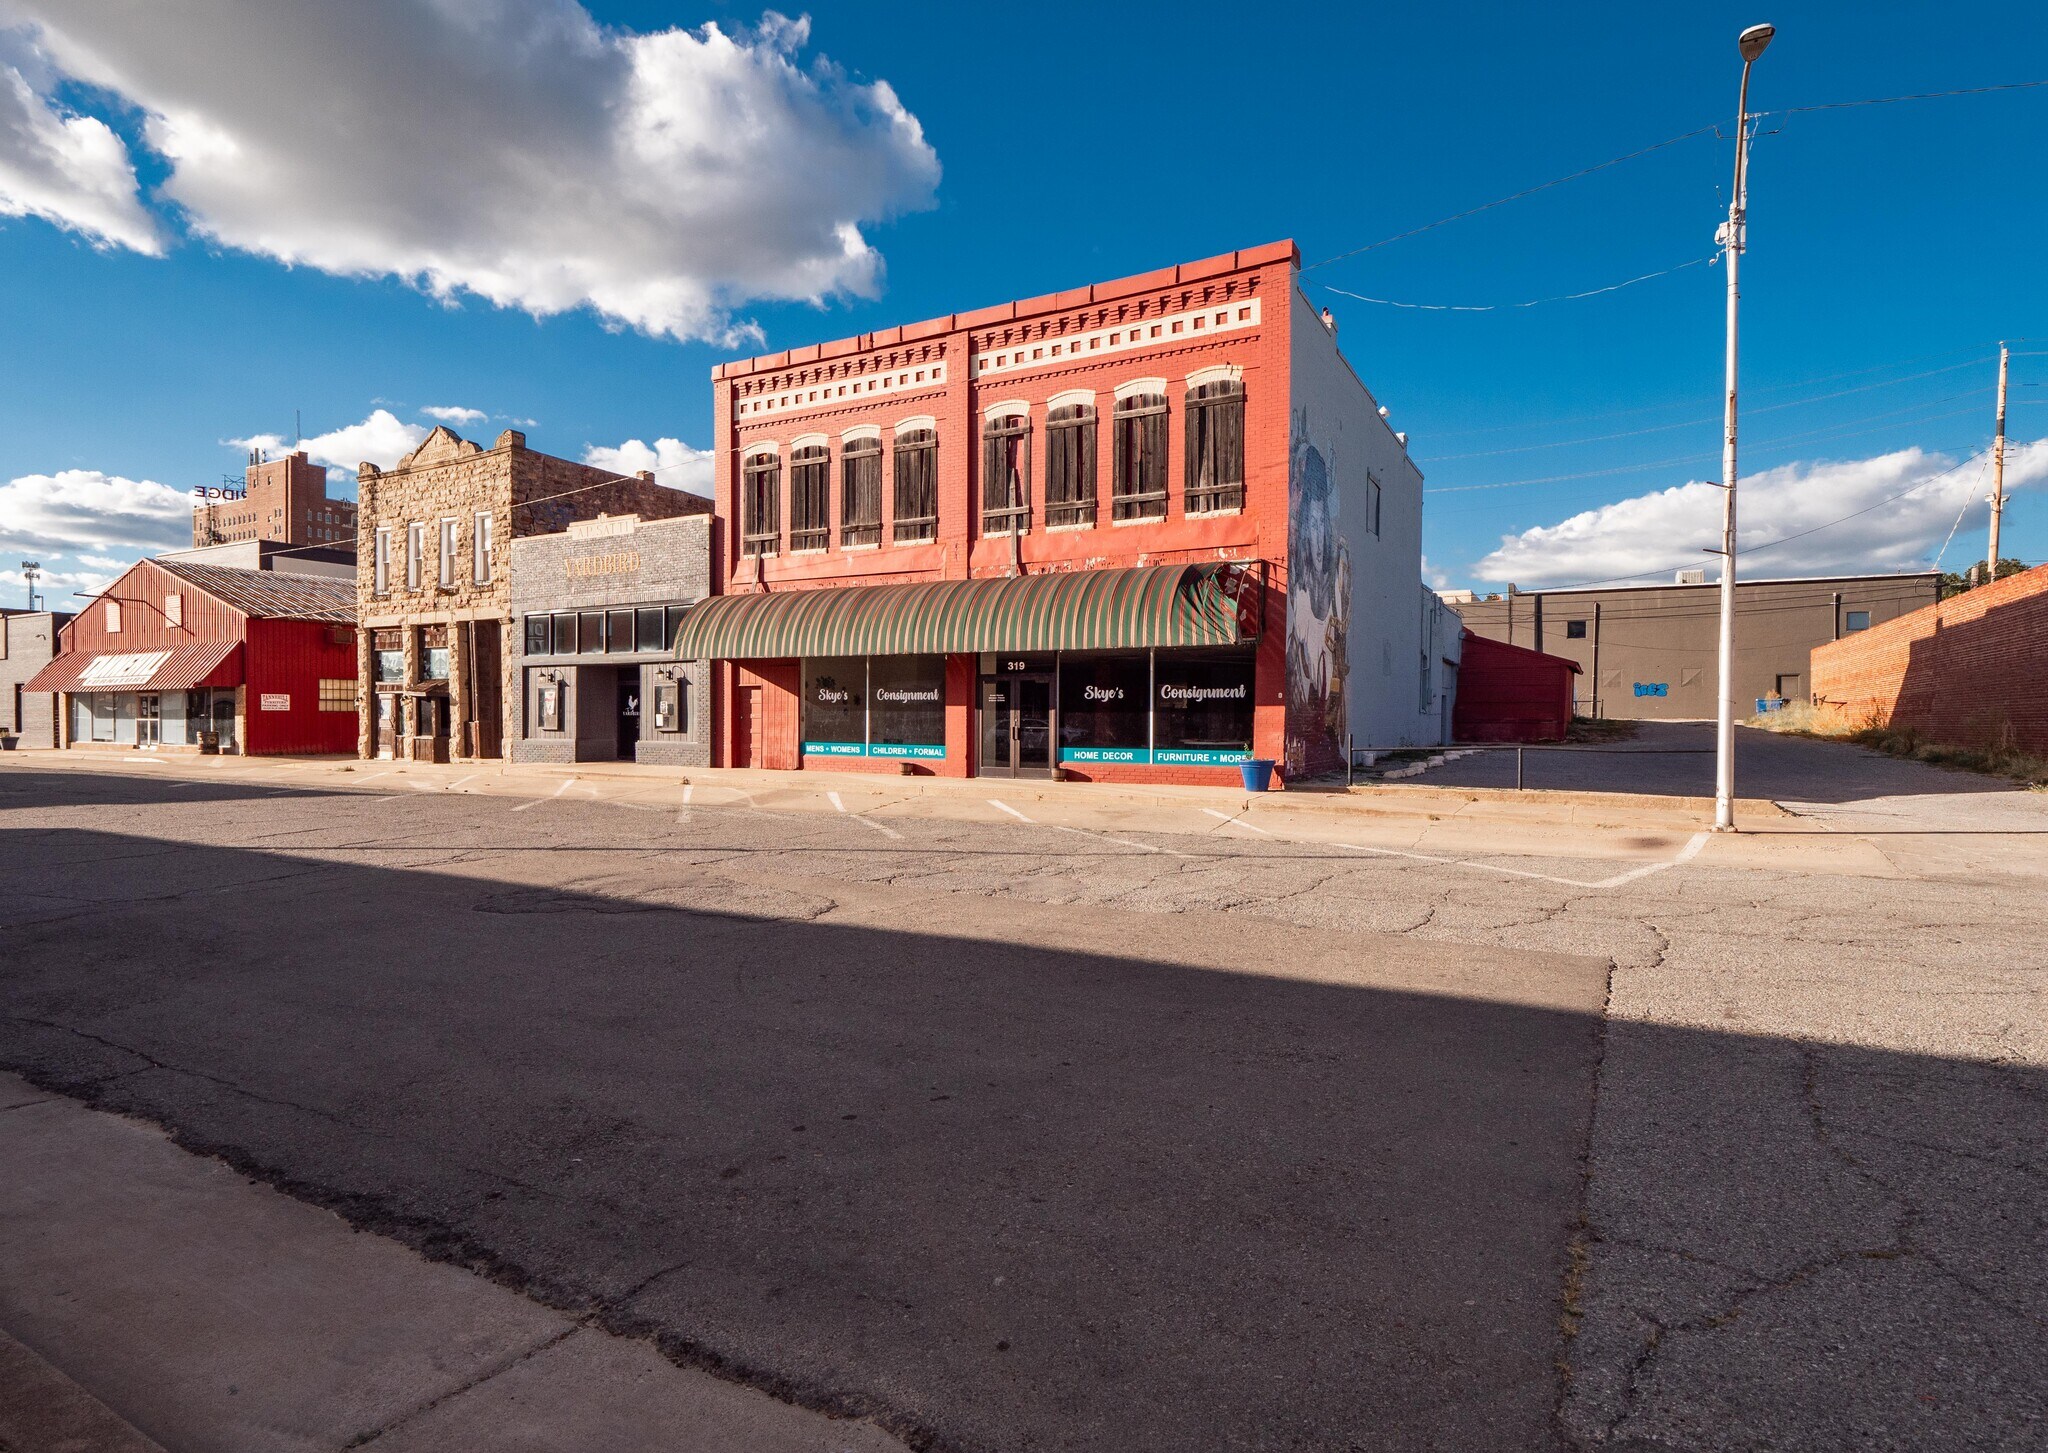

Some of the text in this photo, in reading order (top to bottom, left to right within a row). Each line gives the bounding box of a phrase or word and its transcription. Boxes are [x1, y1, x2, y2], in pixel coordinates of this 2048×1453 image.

[565, 551, 641, 577] YARDBIRD
[1007, 661, 1025, 670] 319
[818, 688, 940, 704] Skye's Consignment
[1083, 684, 1247, 702] Skye's Consignment
[806, 745, 861, 754] MENS WOMENS
[872, 746, 944, 757] CHILDREN FORMAL
[1074, 751, 1133, 761] HOME DECOR
[1157, 752, 1210, 762] FURNITURE
